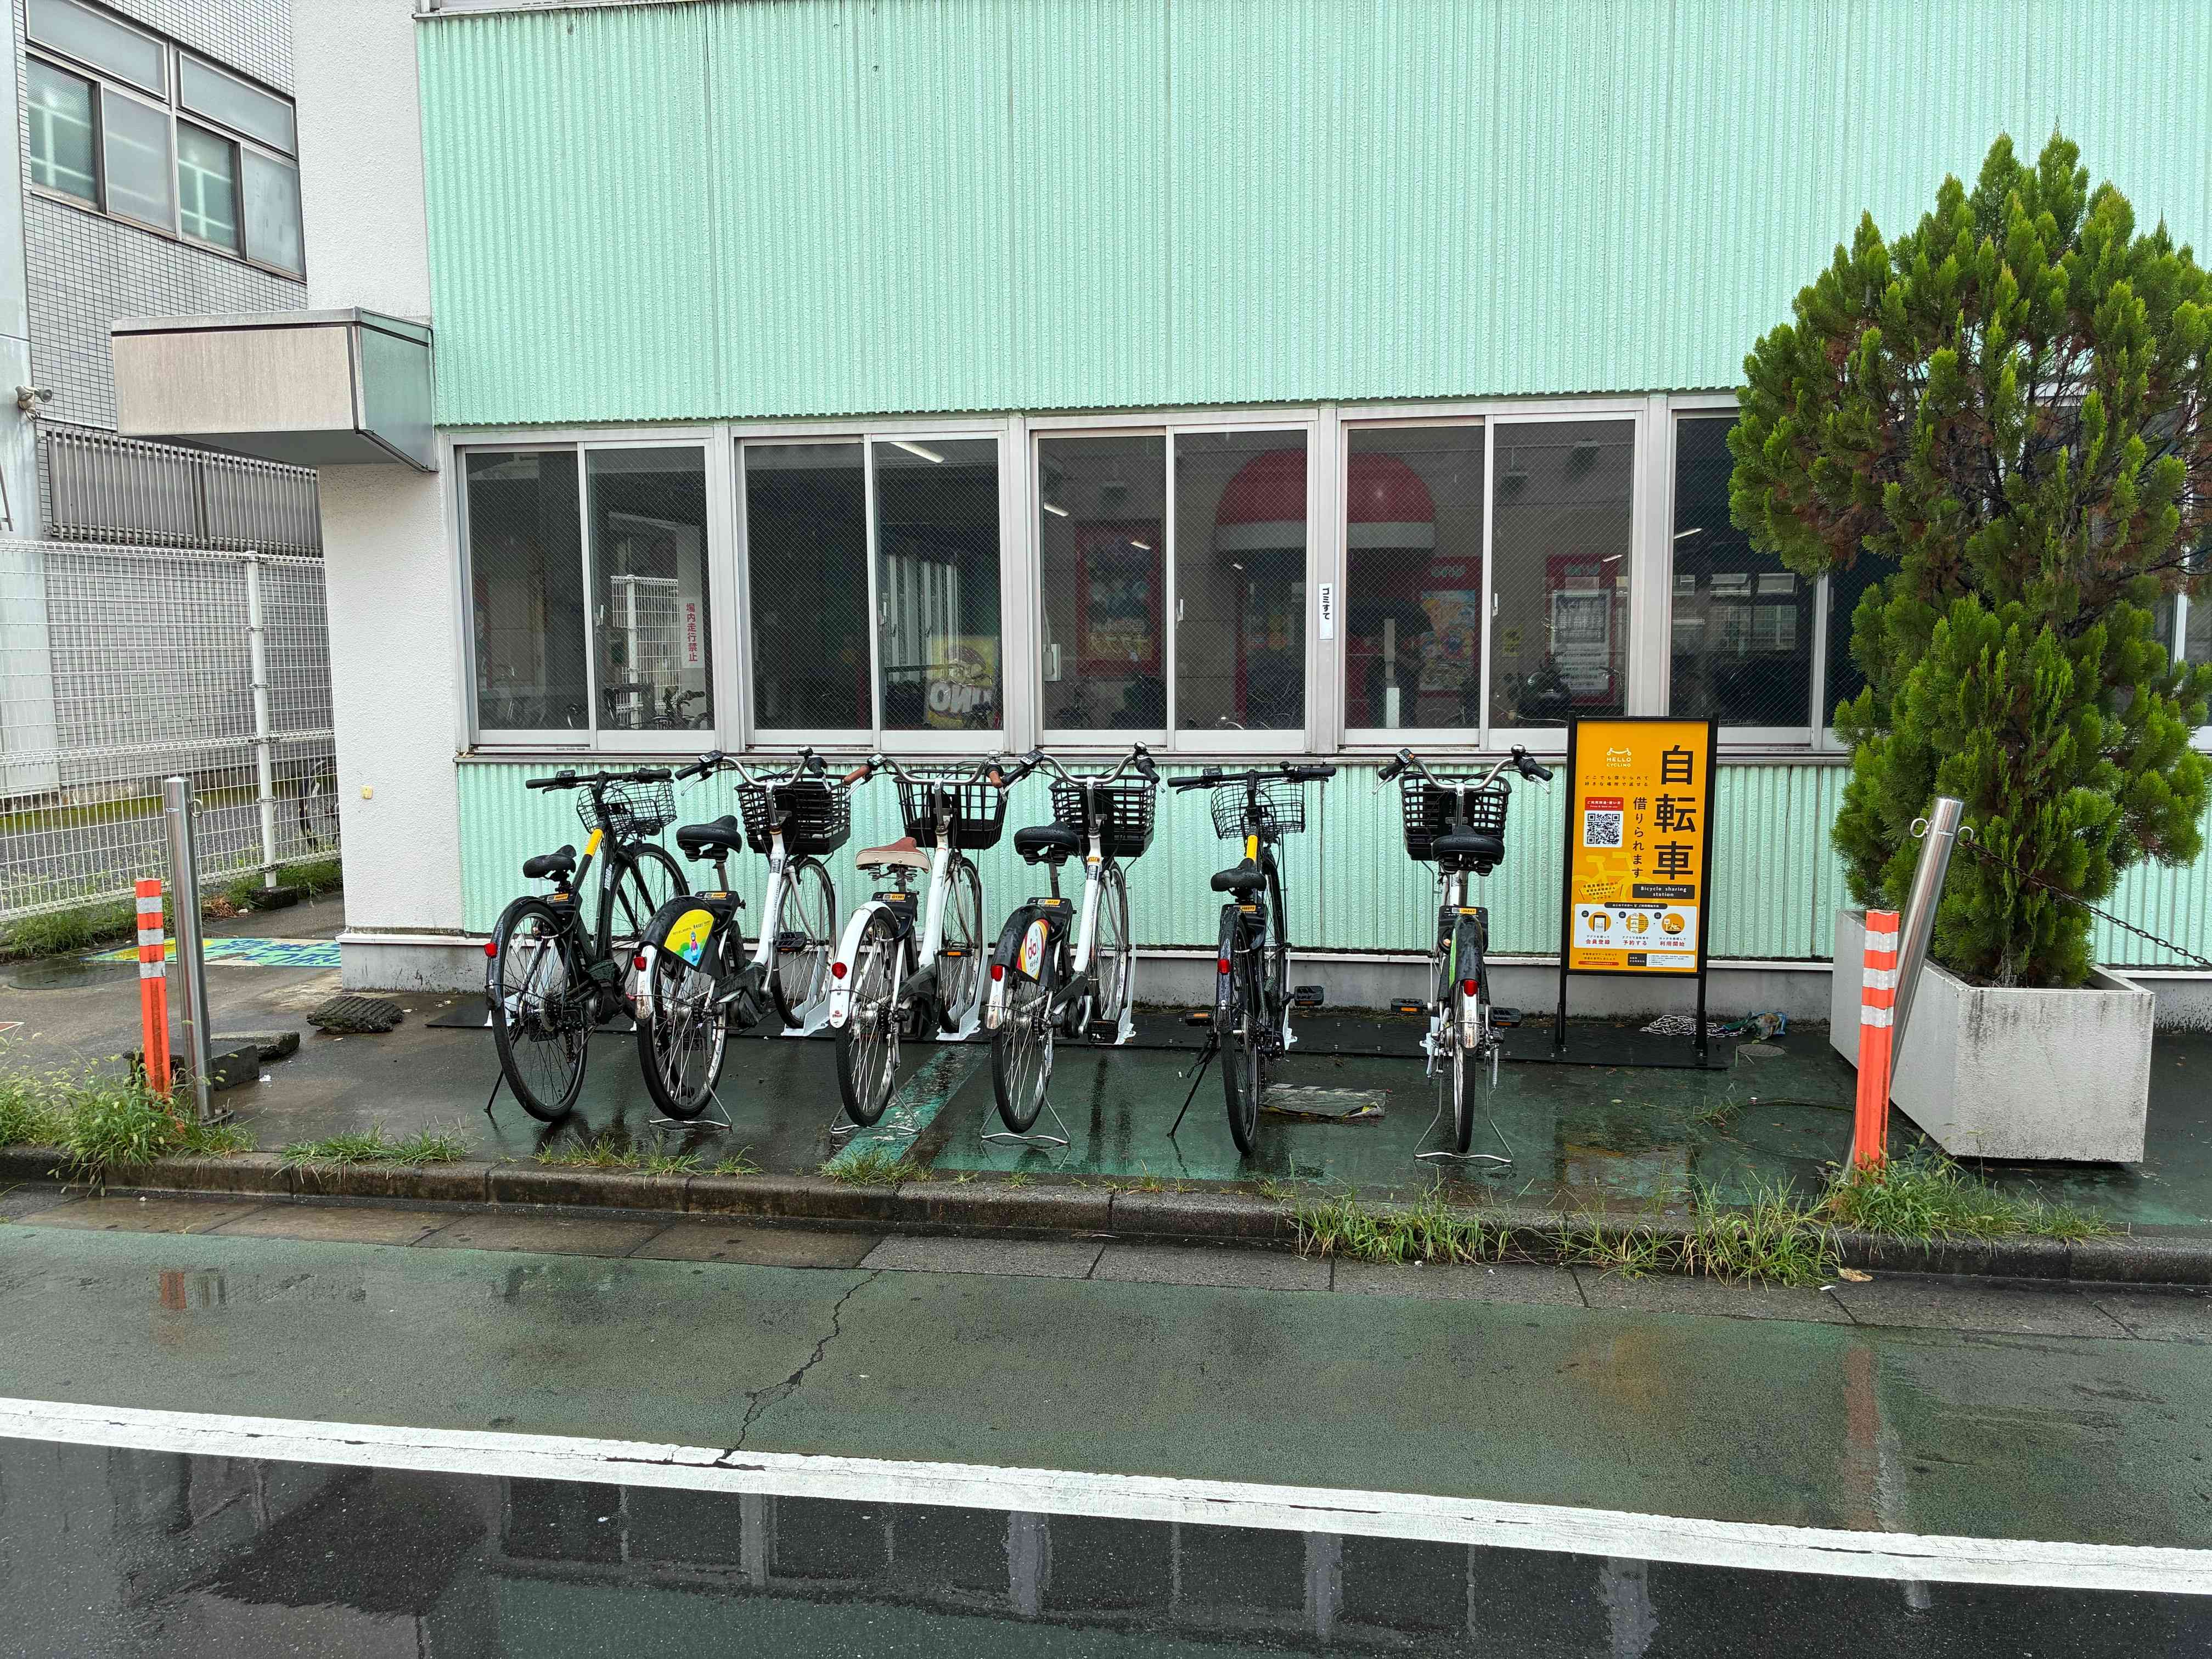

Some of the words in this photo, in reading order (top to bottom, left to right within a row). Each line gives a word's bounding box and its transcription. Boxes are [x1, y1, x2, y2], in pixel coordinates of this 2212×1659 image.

[686, 603, 698, 661] 場内走行禁止
[1631, 797, 1647, 878] 借りられます
[1652, 745, 1696, 880] 自転車
